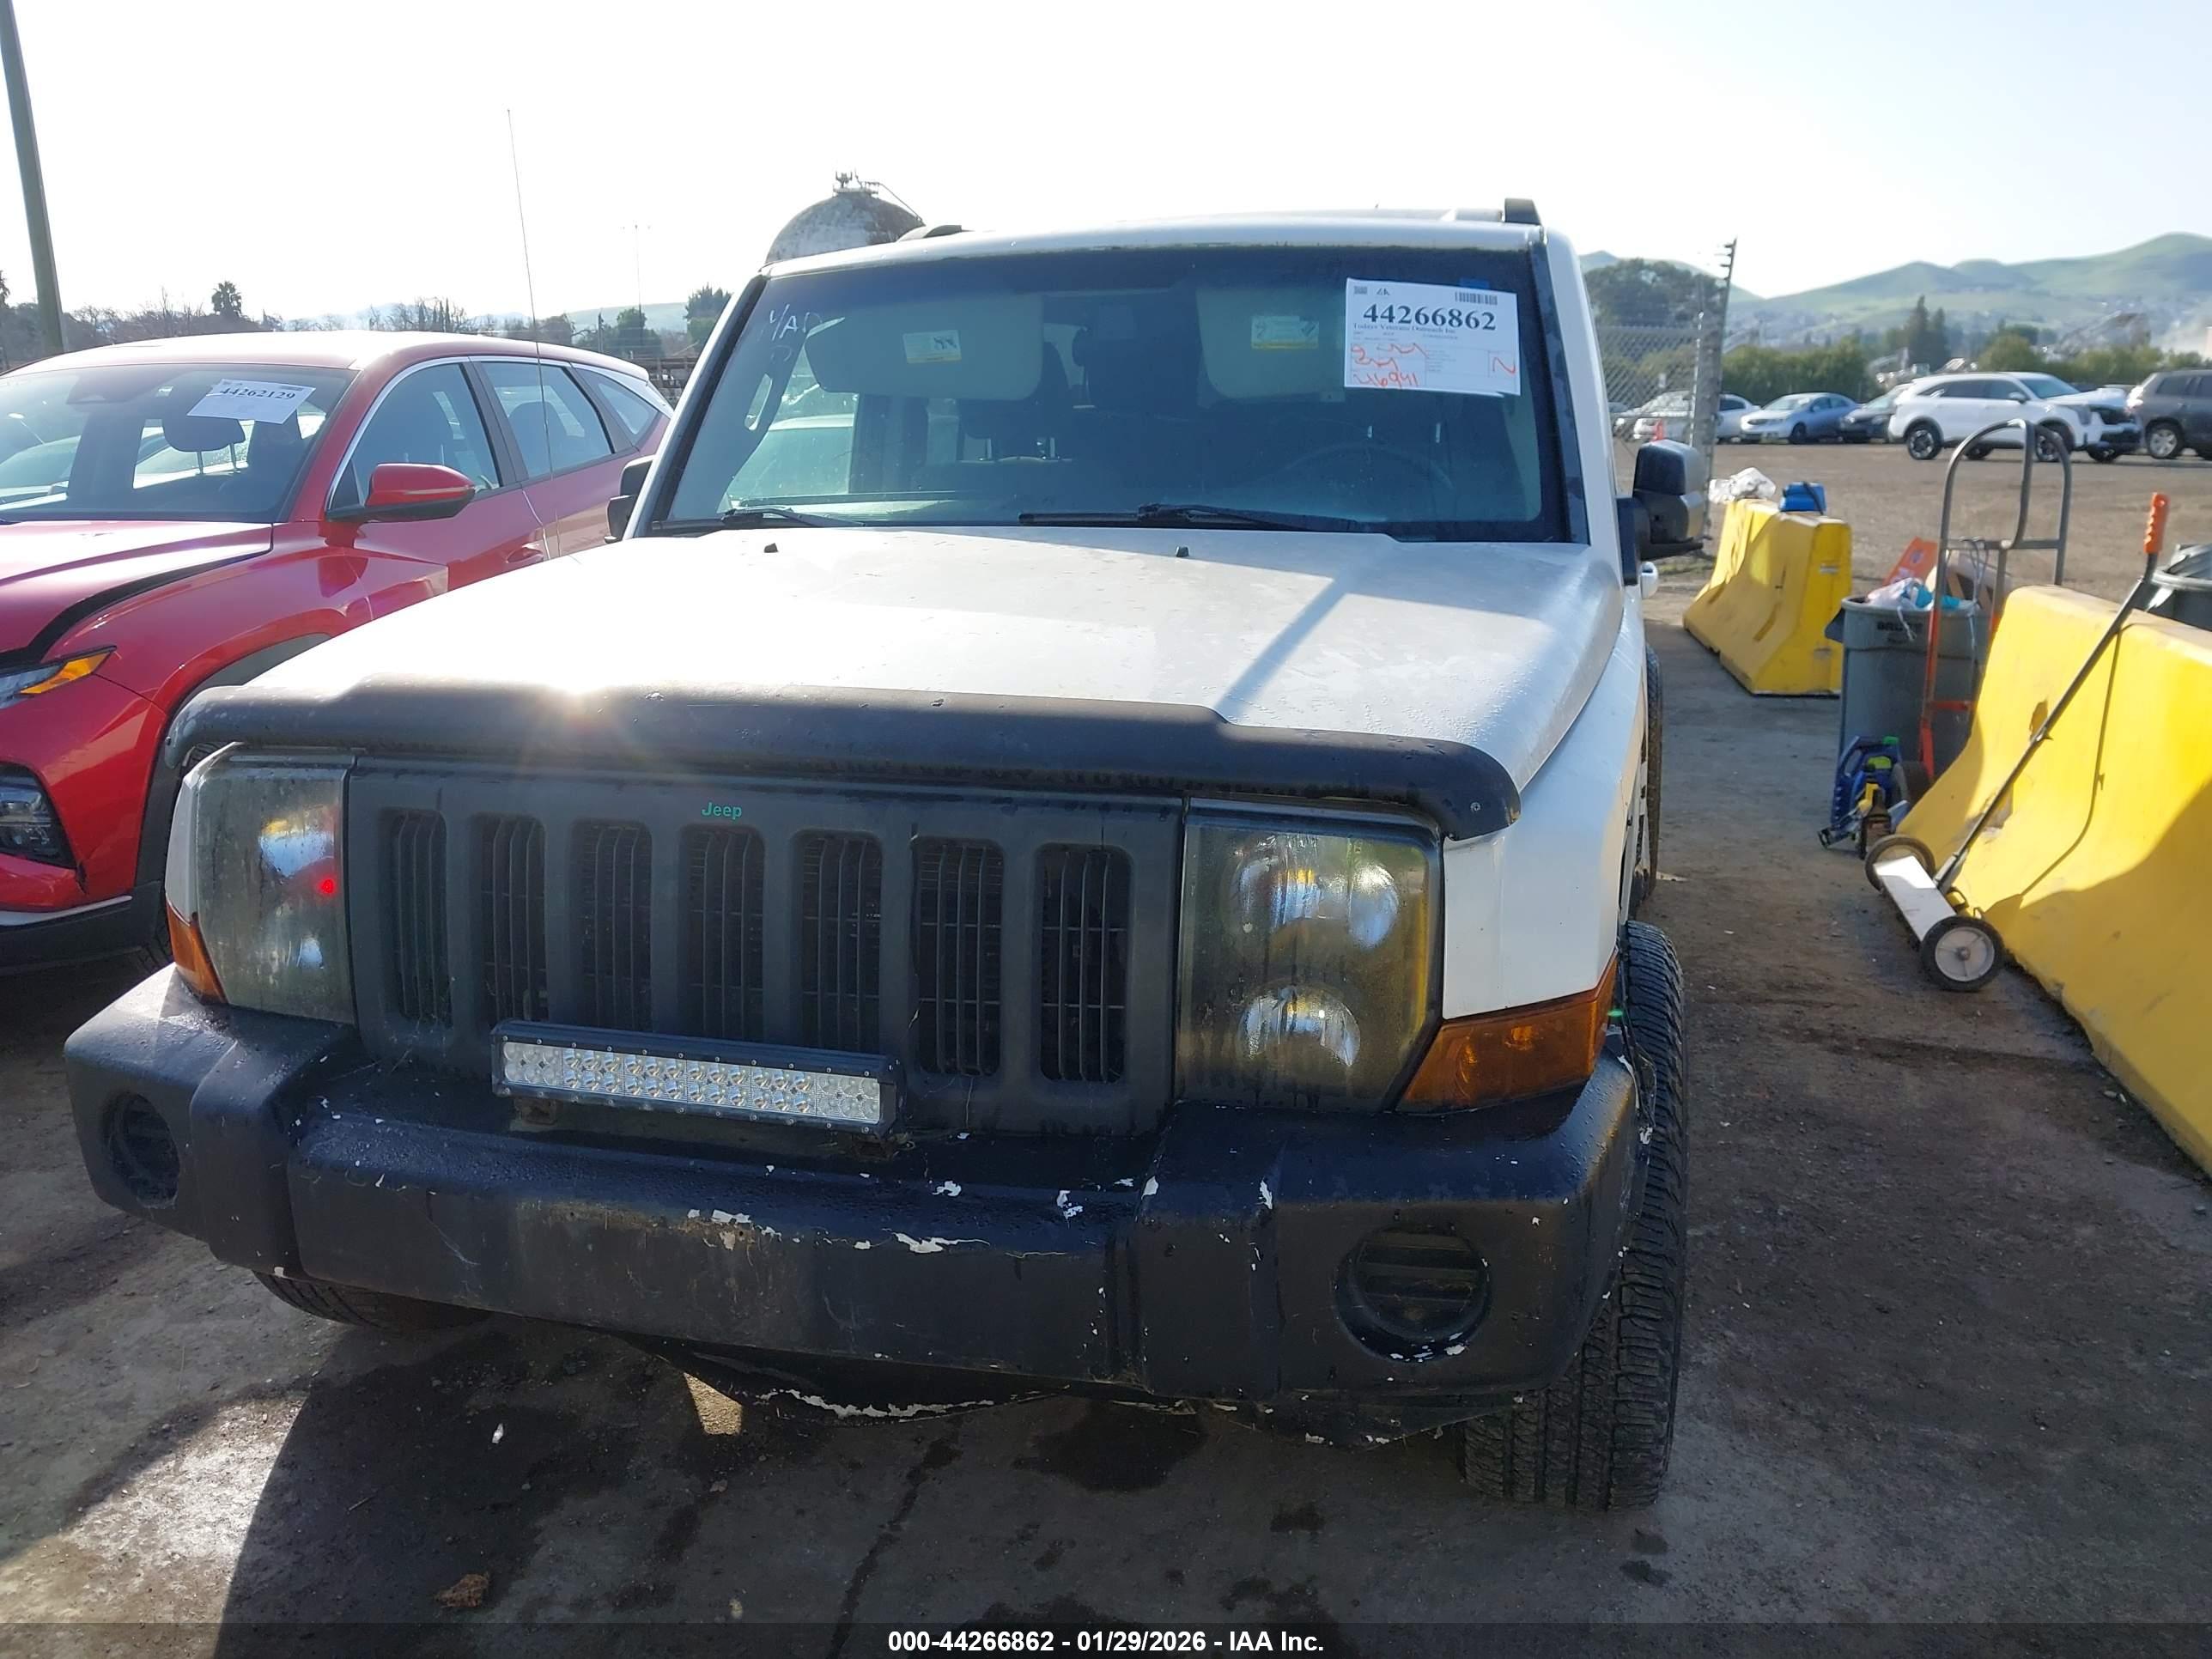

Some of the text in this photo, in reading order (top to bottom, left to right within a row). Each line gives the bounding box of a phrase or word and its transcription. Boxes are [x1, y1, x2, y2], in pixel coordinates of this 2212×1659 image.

[1364, 304, 1497, 331] 44266862
[219, 387, 296, 399] 44262129
[701, 801, 743, 821] Jeep
